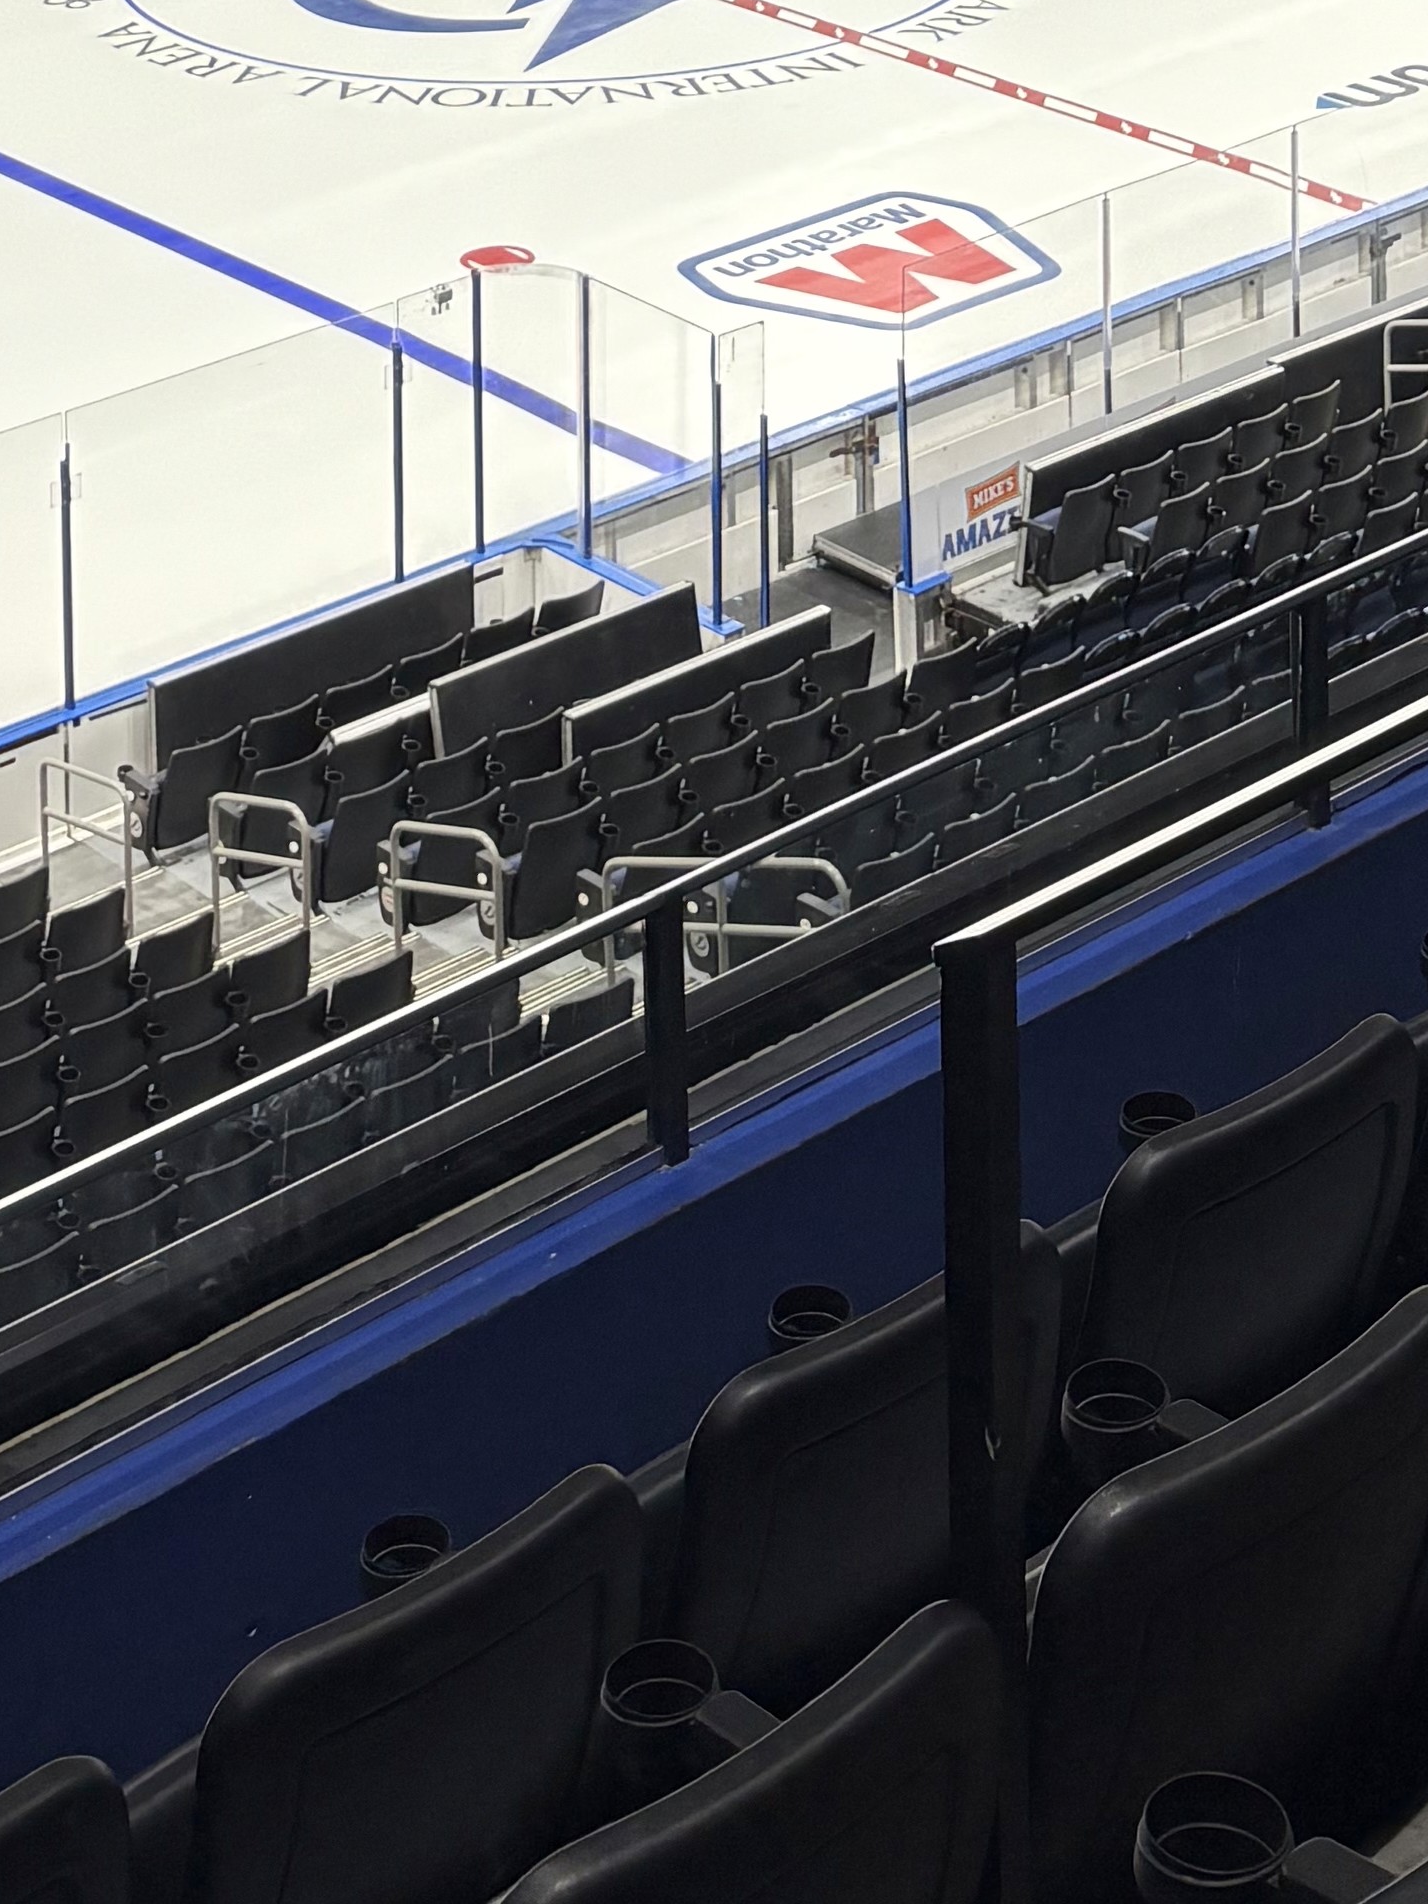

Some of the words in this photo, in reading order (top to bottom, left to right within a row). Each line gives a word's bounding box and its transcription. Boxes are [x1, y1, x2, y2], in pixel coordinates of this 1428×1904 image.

[95, 21, 286, 86] ARENA
[292, 52, 868, 109] INTERNATIONAL
[712, 202, 929, 279] Marathon
[973, 475, 1014, 510] MIKE'S
